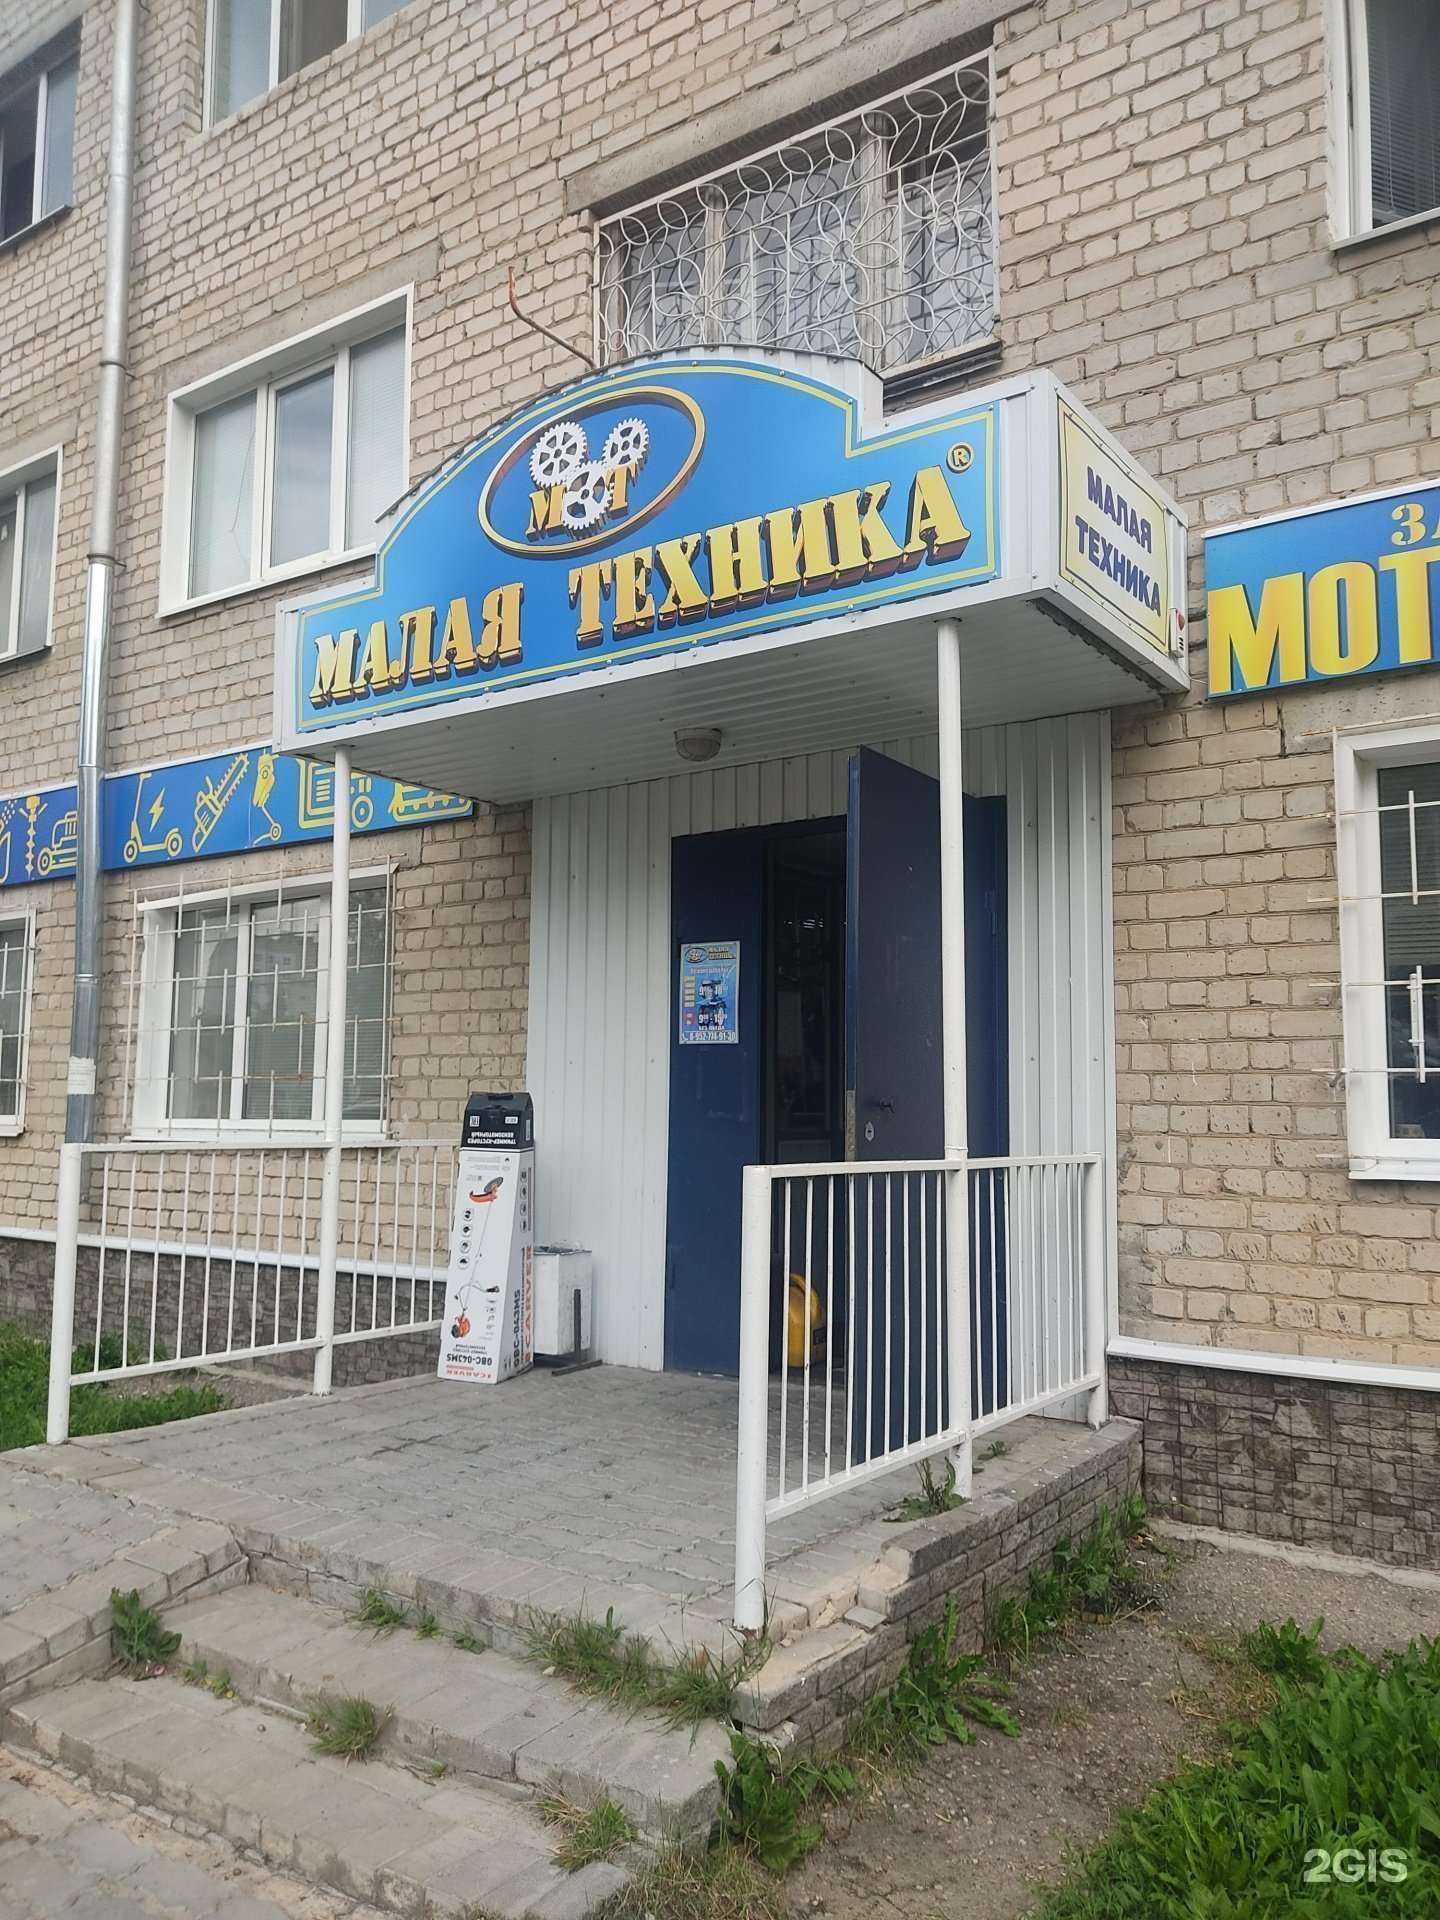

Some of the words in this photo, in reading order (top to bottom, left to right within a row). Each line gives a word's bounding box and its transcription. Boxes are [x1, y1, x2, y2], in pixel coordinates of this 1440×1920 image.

[1086, 465, 1153, 554] МАЛАЯ
[1391, 503, 1440, 546] З
[309, 583, 524, 706] МАЛАЯ
[568, 465, 973, 646] ТЕХНИКА
[1075, 515, 1162, 617] ТЕХНИКА
